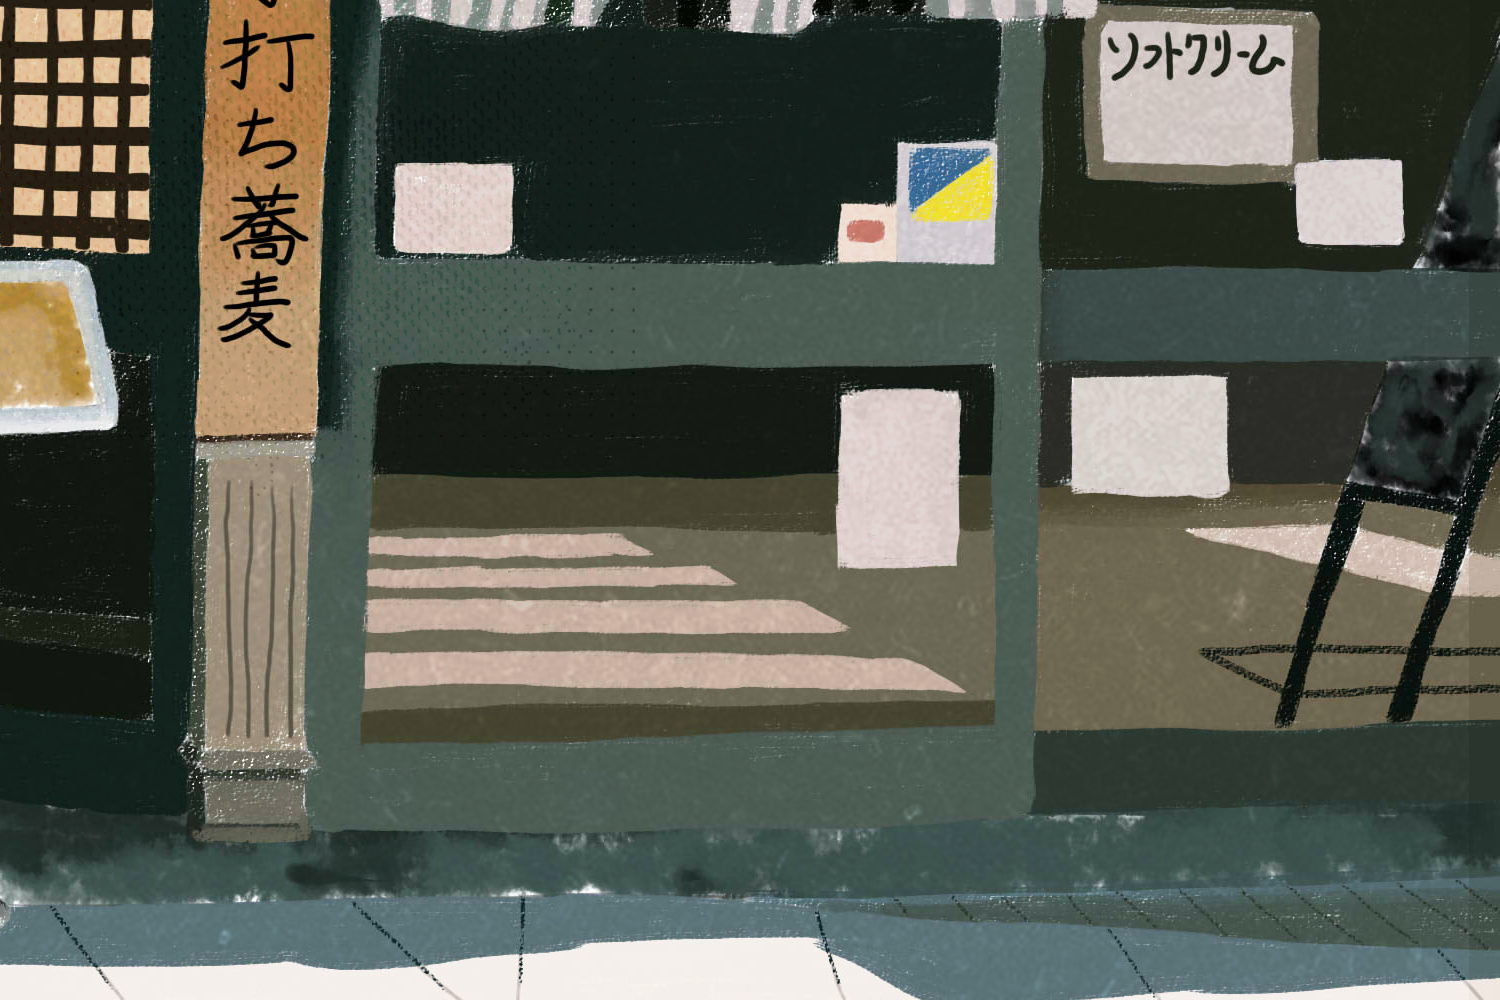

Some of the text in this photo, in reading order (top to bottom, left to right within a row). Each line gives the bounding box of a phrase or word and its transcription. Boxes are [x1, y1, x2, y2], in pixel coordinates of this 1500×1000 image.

[1107, 30, 1286, 81] ソフトクリーム
